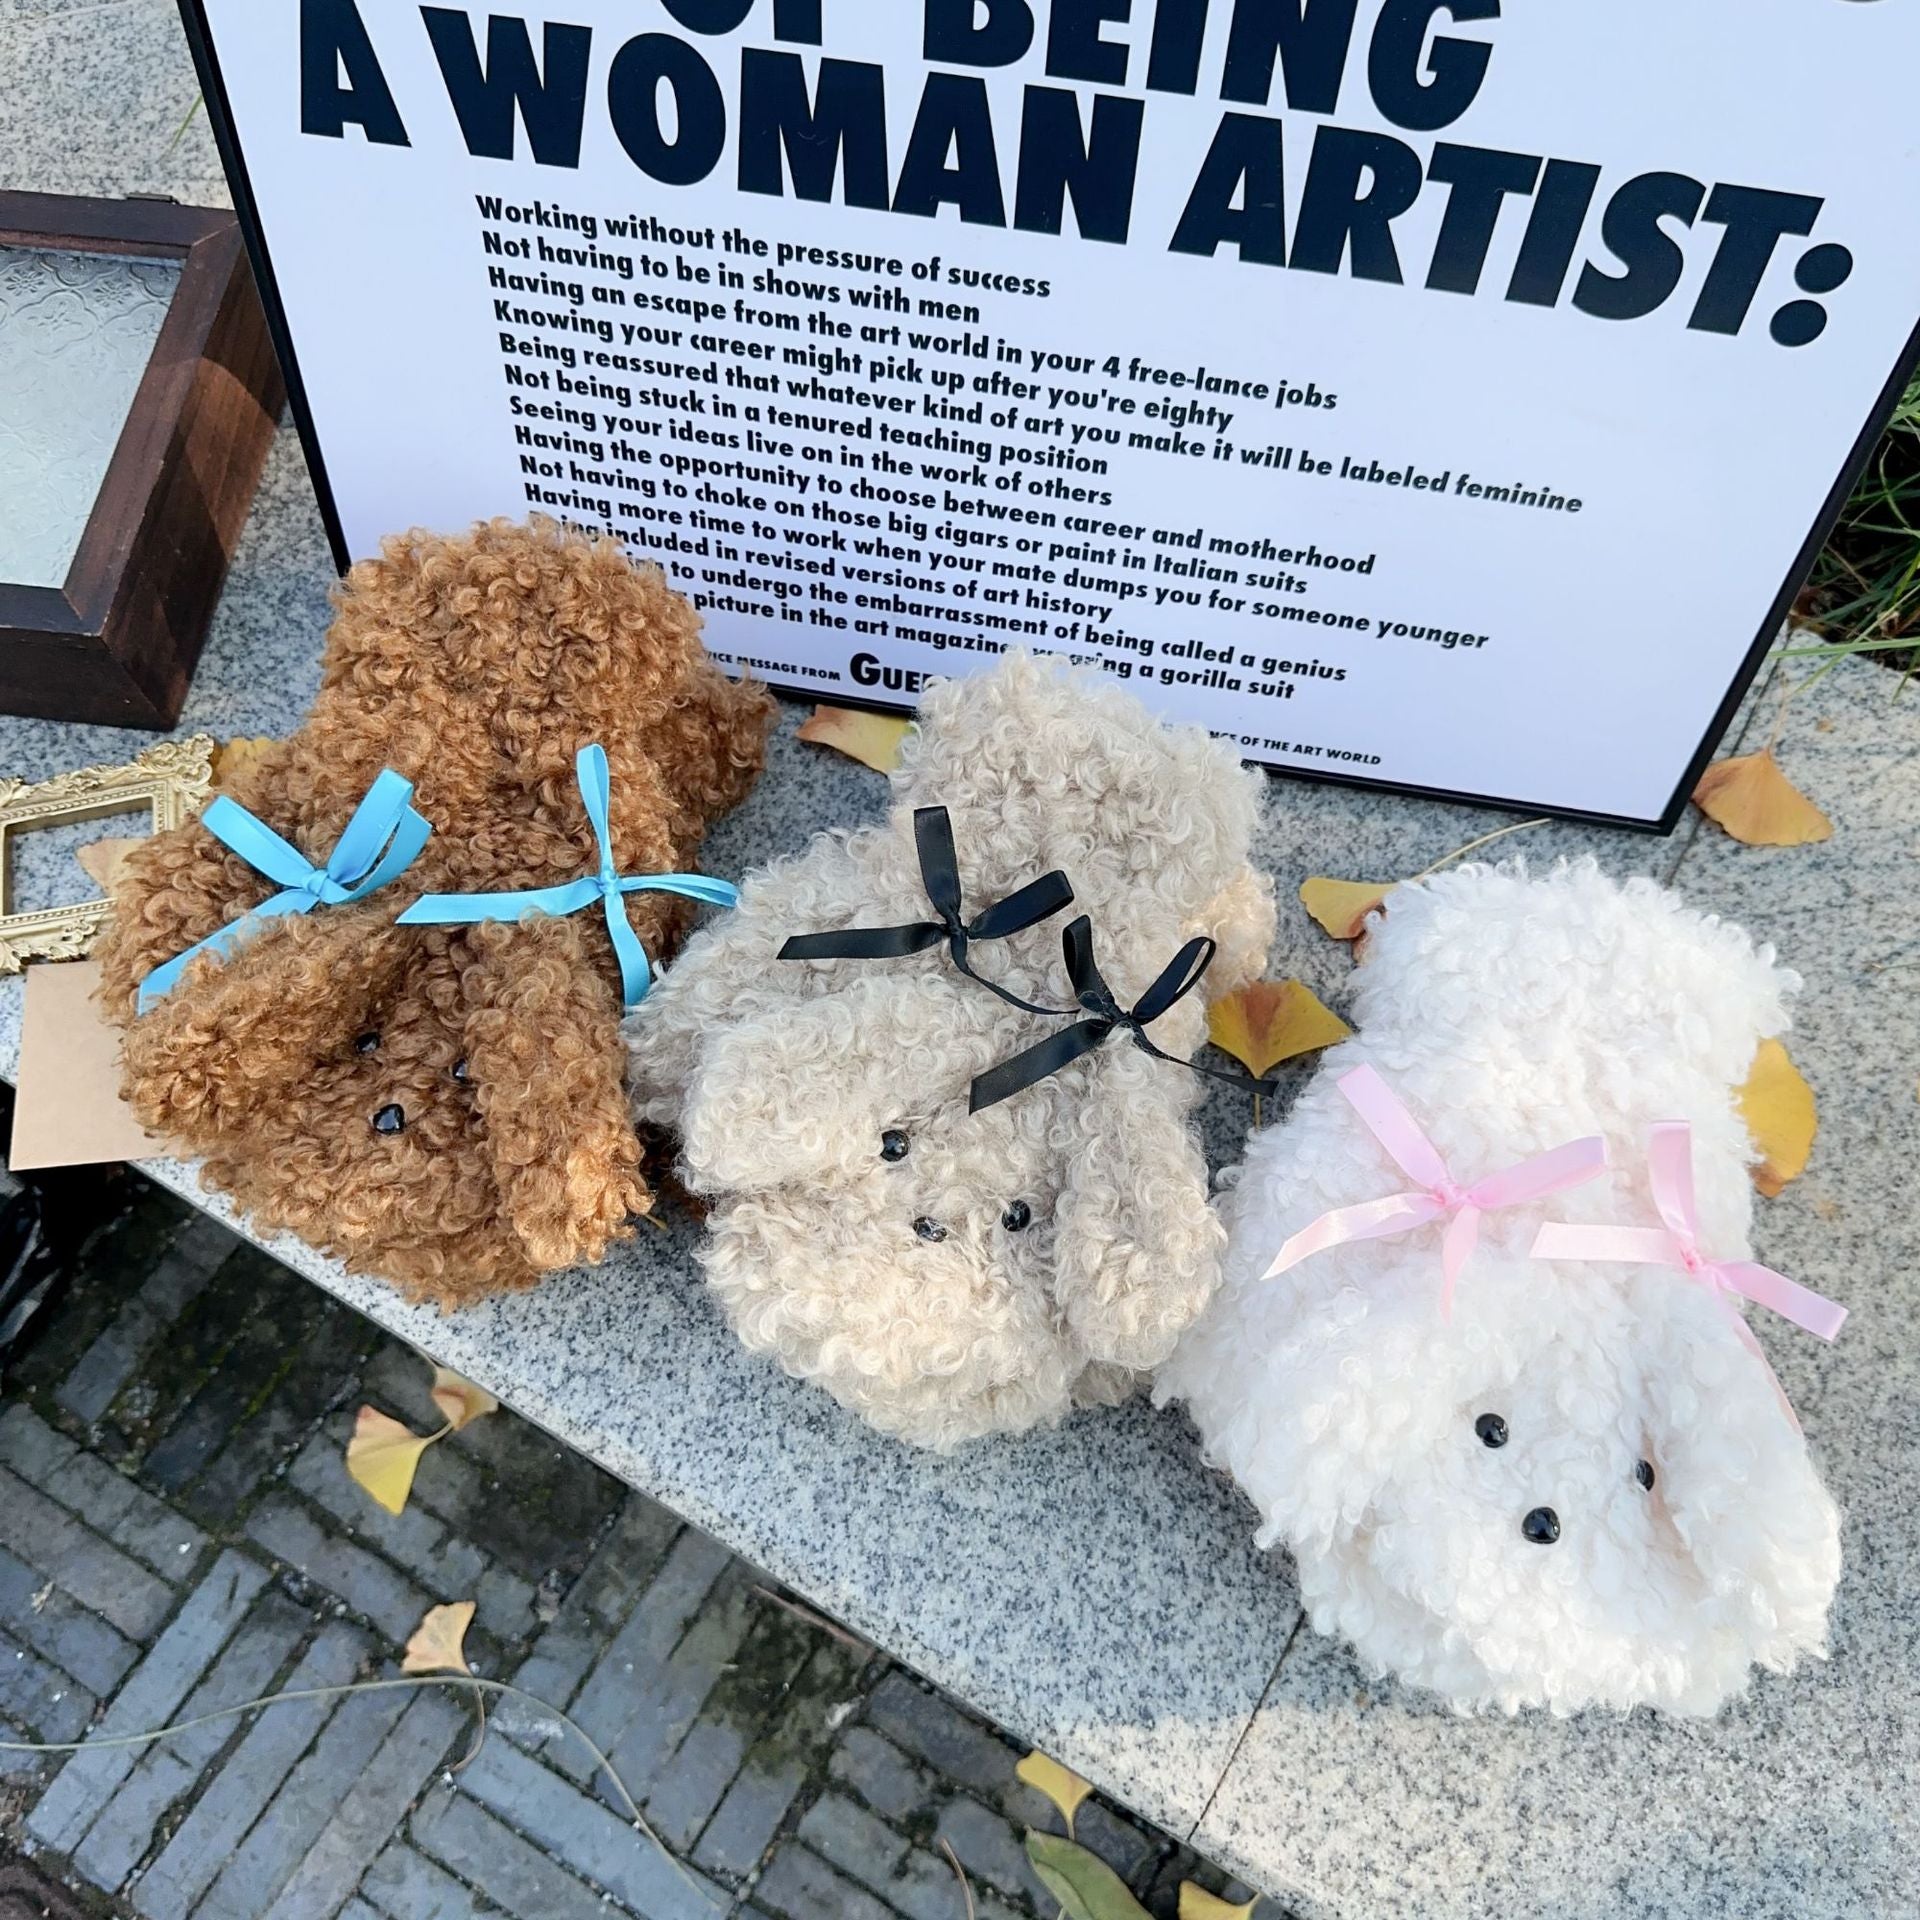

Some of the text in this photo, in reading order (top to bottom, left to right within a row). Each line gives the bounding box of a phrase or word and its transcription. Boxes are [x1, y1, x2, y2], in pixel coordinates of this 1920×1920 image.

[300, 0, 1854, 347] A WOMAN ARTIST:
[474, 194, 1051, 298] Working without the pressure of success
[482, 230, 980, 324] Not having to be in shows with men
[487, 265, 1338, 410] Having an escape from the art world in your 4 free-lance jobs
[493, 298, 1234, 435] Knowing your career might pick up after you're eighty
[498, 332, 1583, 513] Being reassured that whatever kind of art you make it will be labeled feminine
[504, 363, 1108, 475] Not being stuck in a tenured teaching position
[509, 395, 1112, 506] Seeing your ideas live on in the work of others
[514, 424, 1376, 575] Having the opportunity to choose between career and motherhood
[519, 454, 1308, 594] Not having to choke on those big cigars or paint in Italian suits
[524, 482, 1489, 649] Having more time to work when your mate dumps you for someone younger
[670, 560, 695, 580] to
[701, 568, 803, 600] undergo
[808, 581, 848, 605] the
[854, 593, 1049, 636] embarrassment
[1054, 621, 1081, 641] of
[1084, 624, 1155, 657] being
[1161, 639, 1235, 665] called
[1239, 654, 1256, 668] a
[1260, 657, 1347, 681] genius
[715, 539, 739, 562] in
[745, 550, 836, 577] revised
[841, 565, 946, 594] versions
[952, 579, 978, 599] of
[983, 588, 1020, 606] art
[1025, 588, 1113, 624] history
[693, 590, 775, 618] picture
[781, 601, 803, 623] in
[809, 607, 848, 630] the
[854, 619, 890, 637] art
[1139, 664, 1154, 678] a
[1159, 668, 1242, 692] gorilla
[1247, 681, 1295, 699] suit
[801, 666, 841, 681] FROM
[1240, 735, 1260, 747] OF
[1263, 738, 1290, 752] THE
[1292, 744, 1323, 756] ART
[1326, 748, 1381, 765] WORLD
